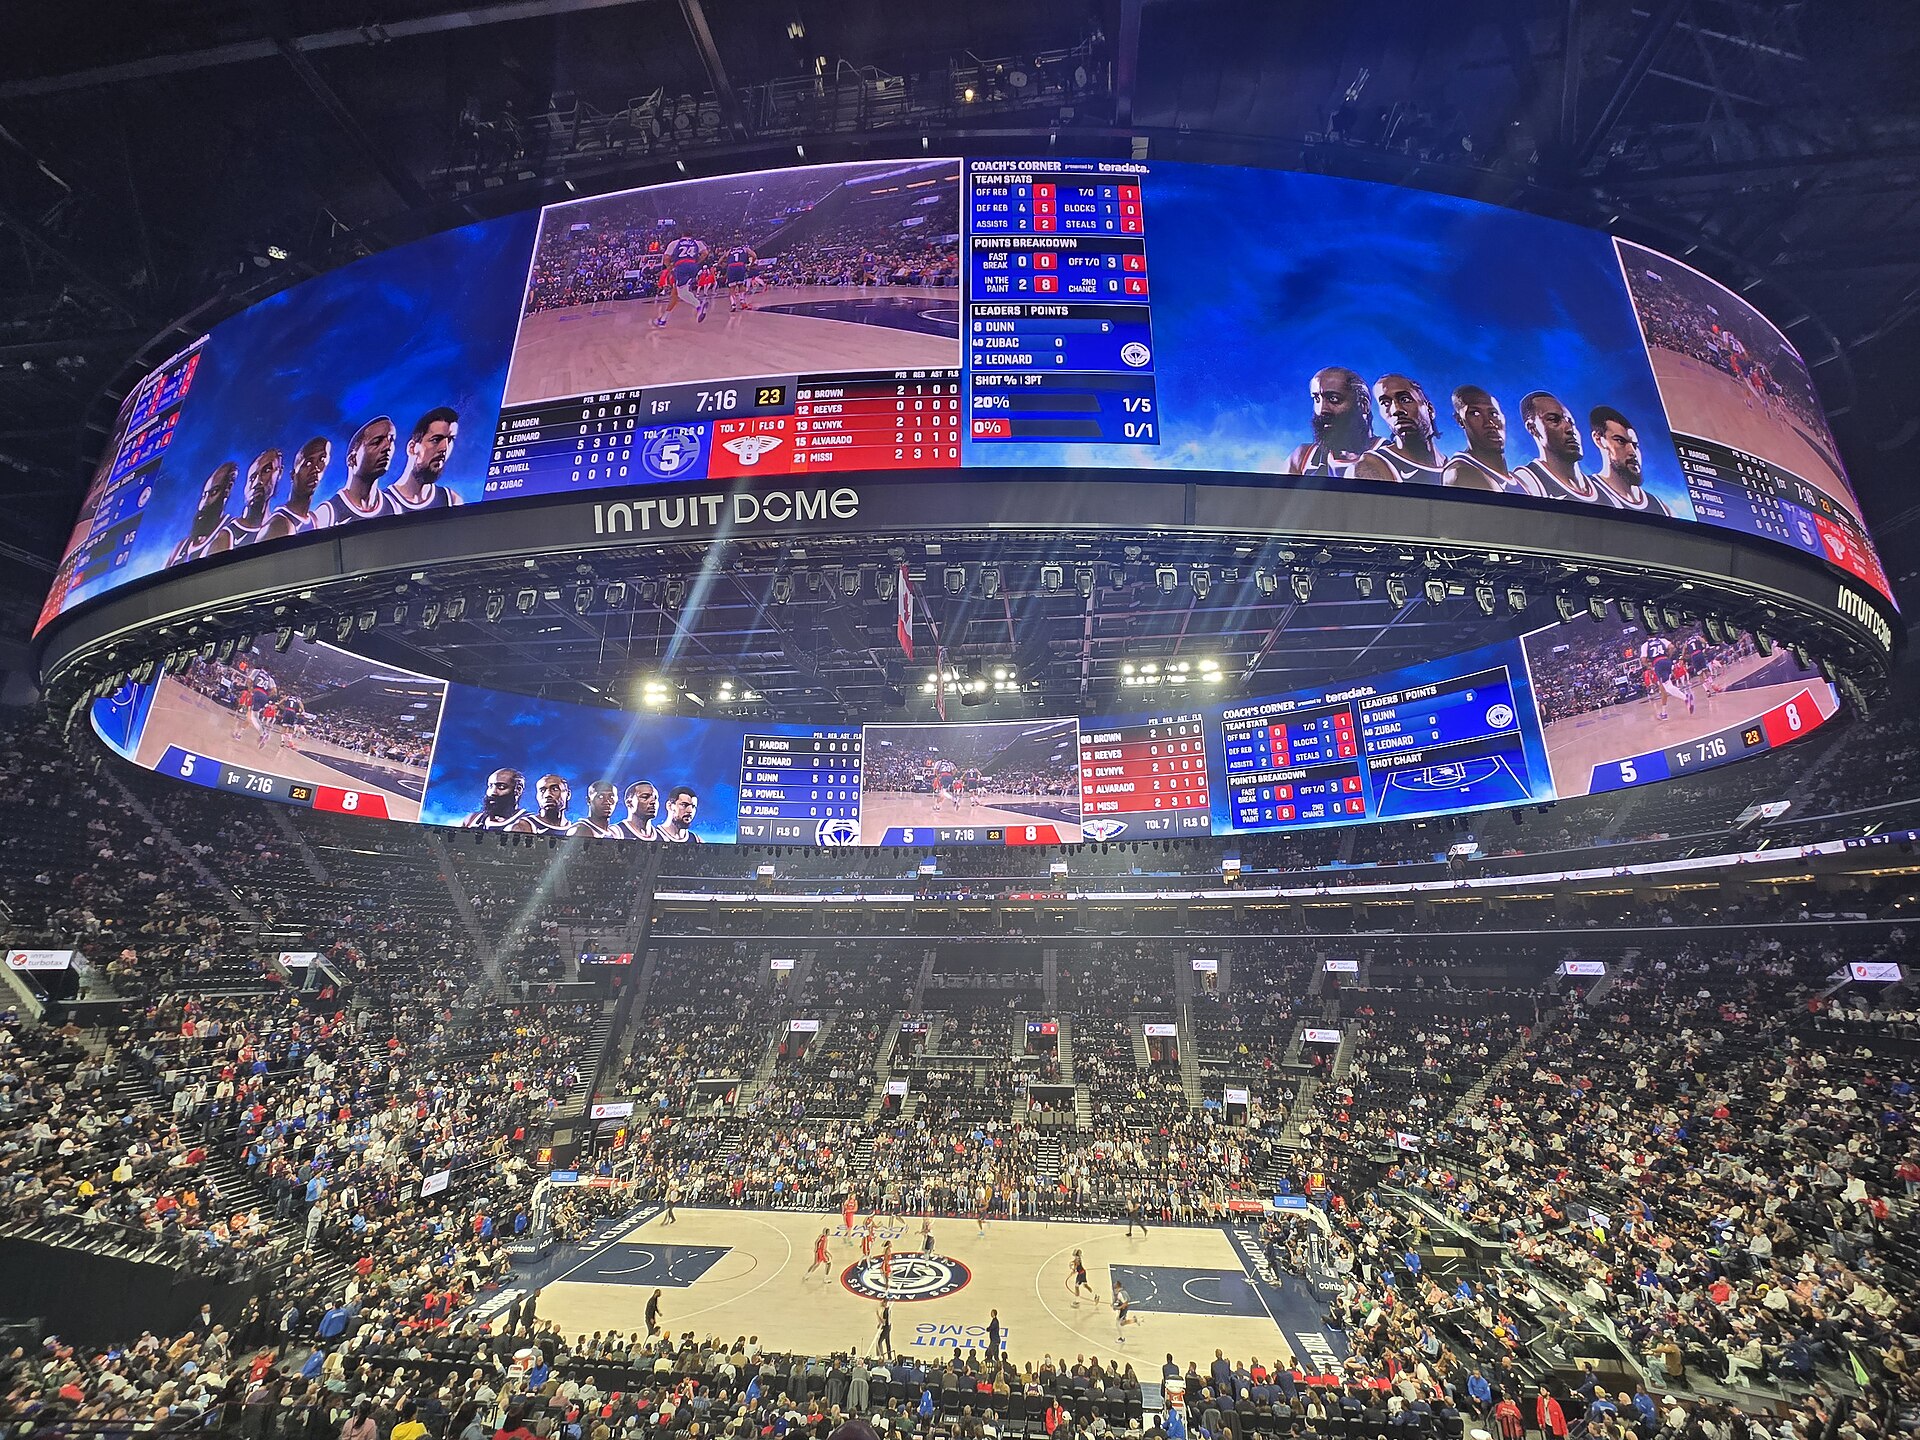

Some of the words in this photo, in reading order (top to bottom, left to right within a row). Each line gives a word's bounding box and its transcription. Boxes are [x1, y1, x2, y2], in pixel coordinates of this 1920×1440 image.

[971, 162, 1016, 170] COACH'S
[1018, 161, 1061, 170] CORNER
[1104, 189, 1111, 197] 2
[1127, 190, 1131, 198] 1
[1019, 204, 1025, 212] 4
[1042, 204, 1048, 212] 5
[1128, 206, 1134, 214] 0
[1020, 220, 1026, 228] 2
[1042, 220, 1049, 228] 2
[1106, 221, 1113, 229] 0
[1129, 222, 1135, 230] 2
[975, 239, 1011, 247] POINTS
[1013, 239, 1077, 247] BREAKDOWN
[679, 246, 696, 258] 24
[1018, 257, 1026, 266] 0
[1041, 257, 1049, 266] 0
[1069, 258, 1083, 266] OFF
[1108, 258, 1116, 268] 3
[1131, 259, 1138, 268] 4
[1019, 280, 1027, 289] 2
[1042, 280, 1050, 289] 8
[1110, 281, 1117, 290] 0
[1132, 282, 1140, 292] 4
[975, 306, 1021, 315] LEADERS
[1031, 307, 1068, 315] POINTS
[974, 322, 982, 331] 8
[986, 322, 1014, 331] DUNN
[986, 338, 1019, 348] ZUBAC
[1056, 338, 1062, 347] 0
[974, 355, 982, 364] 2
[987, 355, 1032, 364] LEONARD
[1056, 355, 1063, 363] 0
[975, 376, 1002, 385] SHOT
[1004, 376, 1017, 384] %
[1025, 376, 1042, 384] 3PT
[760, 390, 780, 404] 23
[798, 390, 811, 399] 00
[815, 389, 843, 398] BROWN
[697, 390, 736, 412] 7:16
[974, 396, 1009, 408] 20%
[1123, 398, 1151, 412] 1/5
[651, 401, 670, 414] 1ST
[798, 406, 808, 414] 12
[814, 405, 842, 413] REEVES
[512, 418, 539, 428] HARDEN
[720, 424, 734, 433] TOL
[739, 423, 745, 431] 7
[759, 422, 774, 430] FLS
[778, 420, 784, 429] 0
[797, 422, 807, 430] 13
[813, 420, 842, 429] OLYNYK
[661, 430, 667, 438] 7
[698, 426, 704, 435] 0
[974, 421, 1000, 432] 0%
[1125, 423, 1152, 437] 0/1
[509, 432, 539, 443] LEONARD
[796, 437, 806, 446] 15
[812, 436, 852, 445] ALVARADO
[506, 449, 525, 458] DUNN
[660, 445, 679, 471] 5
[794, 454, 805, 463] 21
[811, 452, 832, 462] MISSI
[503, 463, 529, 473] POWELL
[500, 480, 522, 489] ZUBAC
[1651, 646, 1664, 657] 24
[1362, 695, 1398, 709] LEADERS
[1407, 687, 1436, 700] POINTS
[1223, 706, 1258, 719] COACH'S
[1260, 701, 1295, 714] CORNER
[1372, 710, 1395, 721] DUNN
[1786, 704, 1801, 730] 8
[1226, 722, 1245, 730] TEAM
[1247, 719, 1268, 728] STATS
[1375, 724, 1401, 735] ZUBAC
[1094, 733, 1121, 742] BROWN
[1746, 731, 1759, 744] 23
[760, 741, 789, 750] HARDEN
[1095, 750, 1122, 760] REEVES
[1677, 752, 1690, 766] 1ST
[1697, 738, 1726, 761] 7:16
[181, 756, 196, 776] 5
[758, 758, 791, 766] LEONARD
[1370, 757, 1392, 769] SHOT
[1394, 754, 1422, 765] CHART
[1096, 767, 1124, 776] OLYNYK
[1620, 761, 1637, 782] 5
[228, 772, 240, 784] 1ST
[244, 775, 272, 793] 7:16
[757, 774, 778, 782] DUNN
[1230, 775, 1256, 785] POINTS
[1258, 770, 1306, 782] BREAKDOWN
[1096, 783, 1134, 793] ALVARADO
[293, 789, 306, 798] 23
[756, 790, 785, 798] POWELL
[342, 792, 358, 810] 8
[754, 807, 779, 815] ZUBAC
[1098, 802, 1118, 811] MISSI
[1146, 821, 1160, 829] TOL
[1163, 819, 1169, 829] 7
[1183, 819, 1197, 827] FLS
[1201, 817, 1208, 826] 0
[903, 830, 913, 843] 5
[956, 830, 974, 840] 7:16
[1026, 826, 1037, 840] 8
[578, 1240, 606, 1250] LA
[600, 1207, 659, 1239] CLIPPERS
[507, 1243, 535, 1252] coinbase
